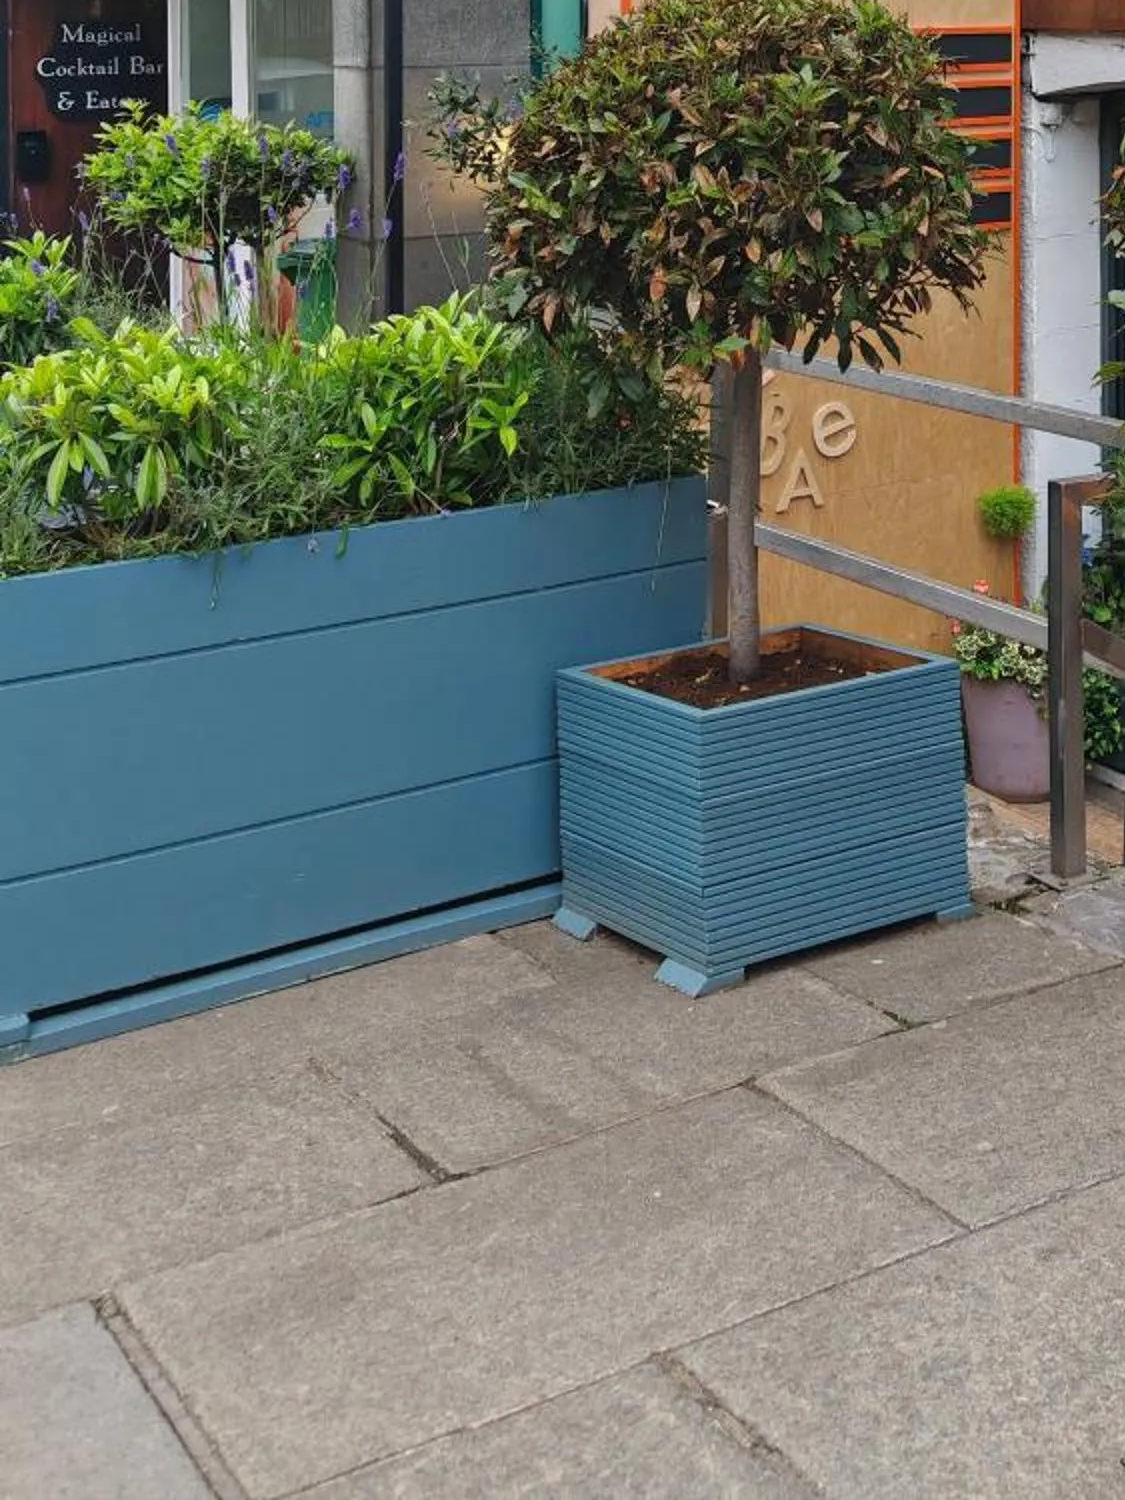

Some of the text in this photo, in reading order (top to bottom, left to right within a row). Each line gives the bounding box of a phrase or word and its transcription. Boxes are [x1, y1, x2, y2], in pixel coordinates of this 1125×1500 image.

[61, 24, 141, 45] Magical
[37, 56, 164, 77] Cocktail Bar
[57, 91, 75, 111] &
